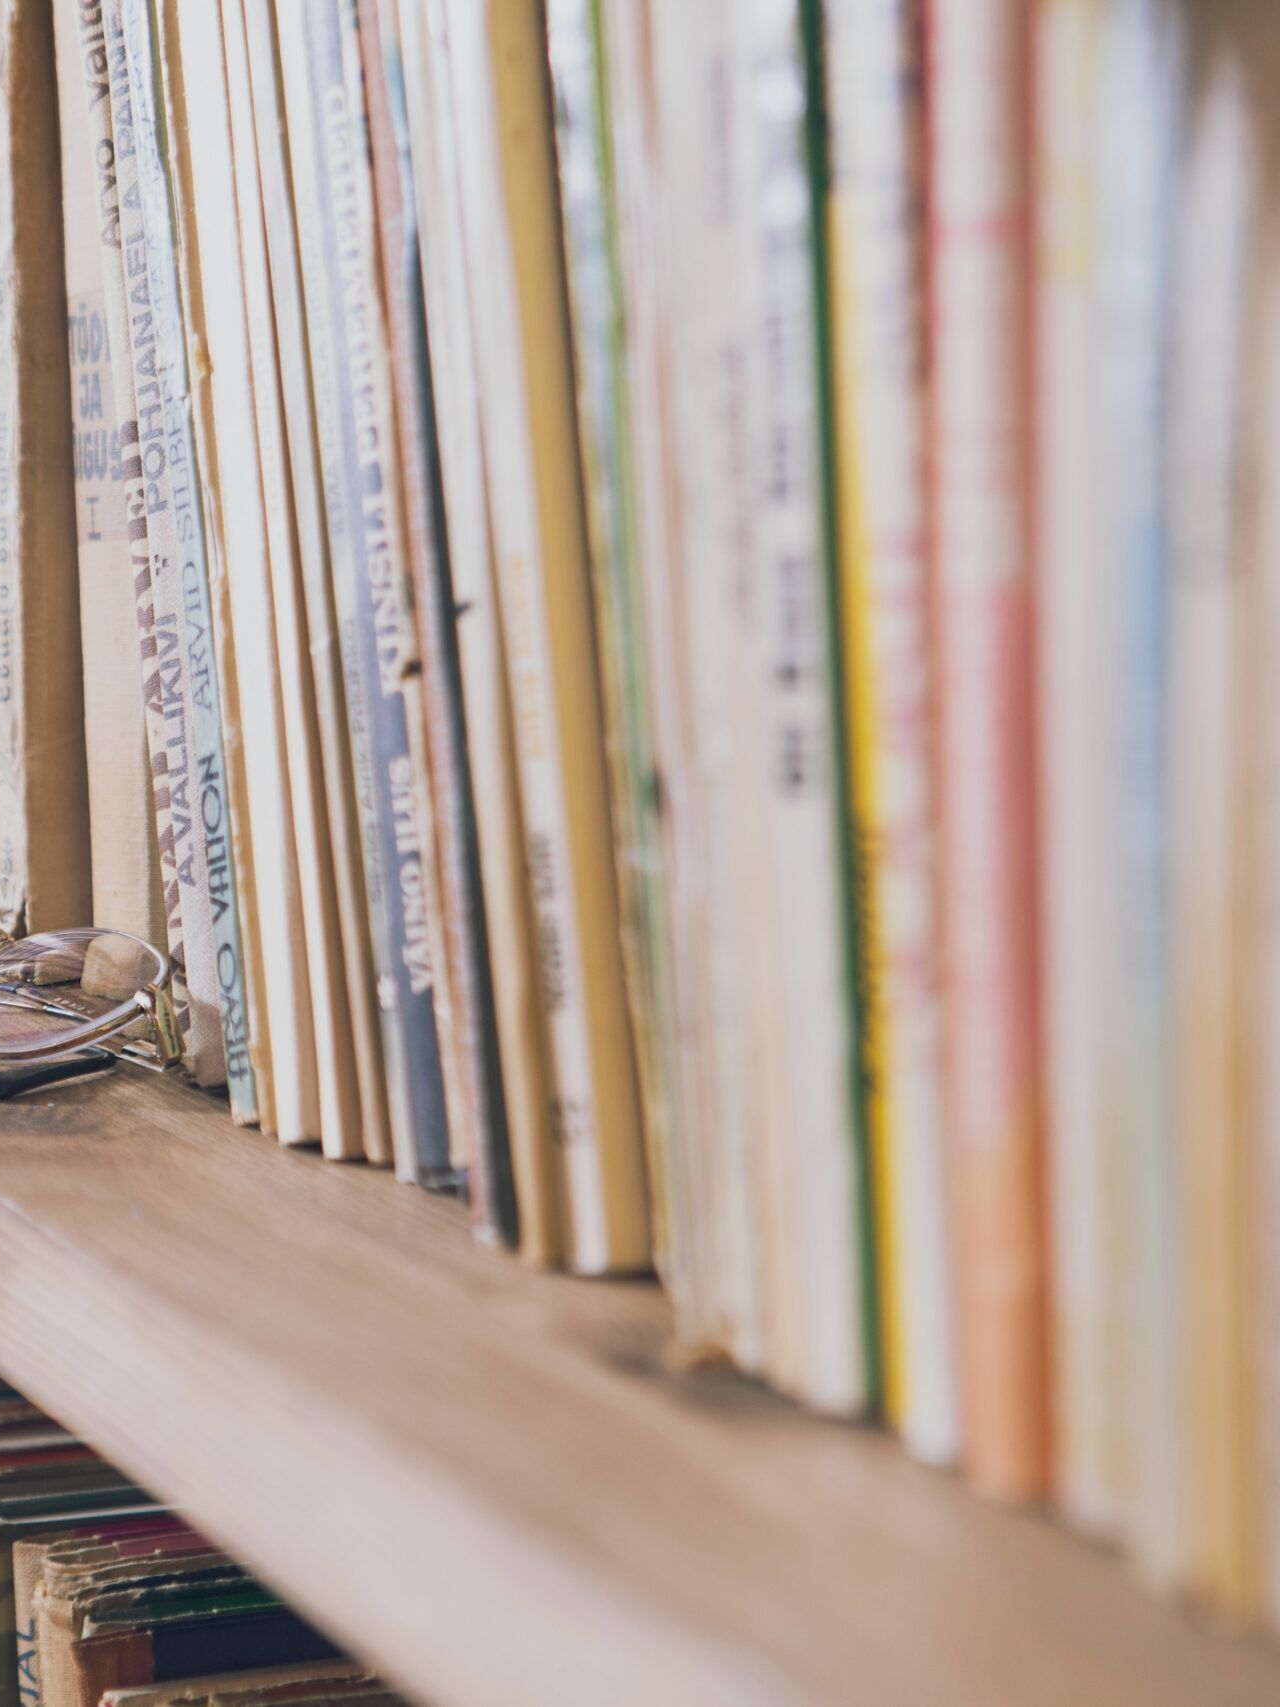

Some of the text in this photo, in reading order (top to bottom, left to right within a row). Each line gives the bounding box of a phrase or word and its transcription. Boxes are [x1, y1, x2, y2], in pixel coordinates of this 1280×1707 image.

[94, 139, 122, 250] Arvo
[73, 428, 123, 482] IGUS
[180, 561, 212, 711] ARVID
[361, 494, 407, 698] KINSLI
[156, 613, 196, 888] A.VALLIKIVI
[388, 756, 419, 853] ILUS
[197, 754, 230, 924] VALTON
[400, 860, 433, 993] VÄINO
[216, 943, 249, 1081] ARVO
